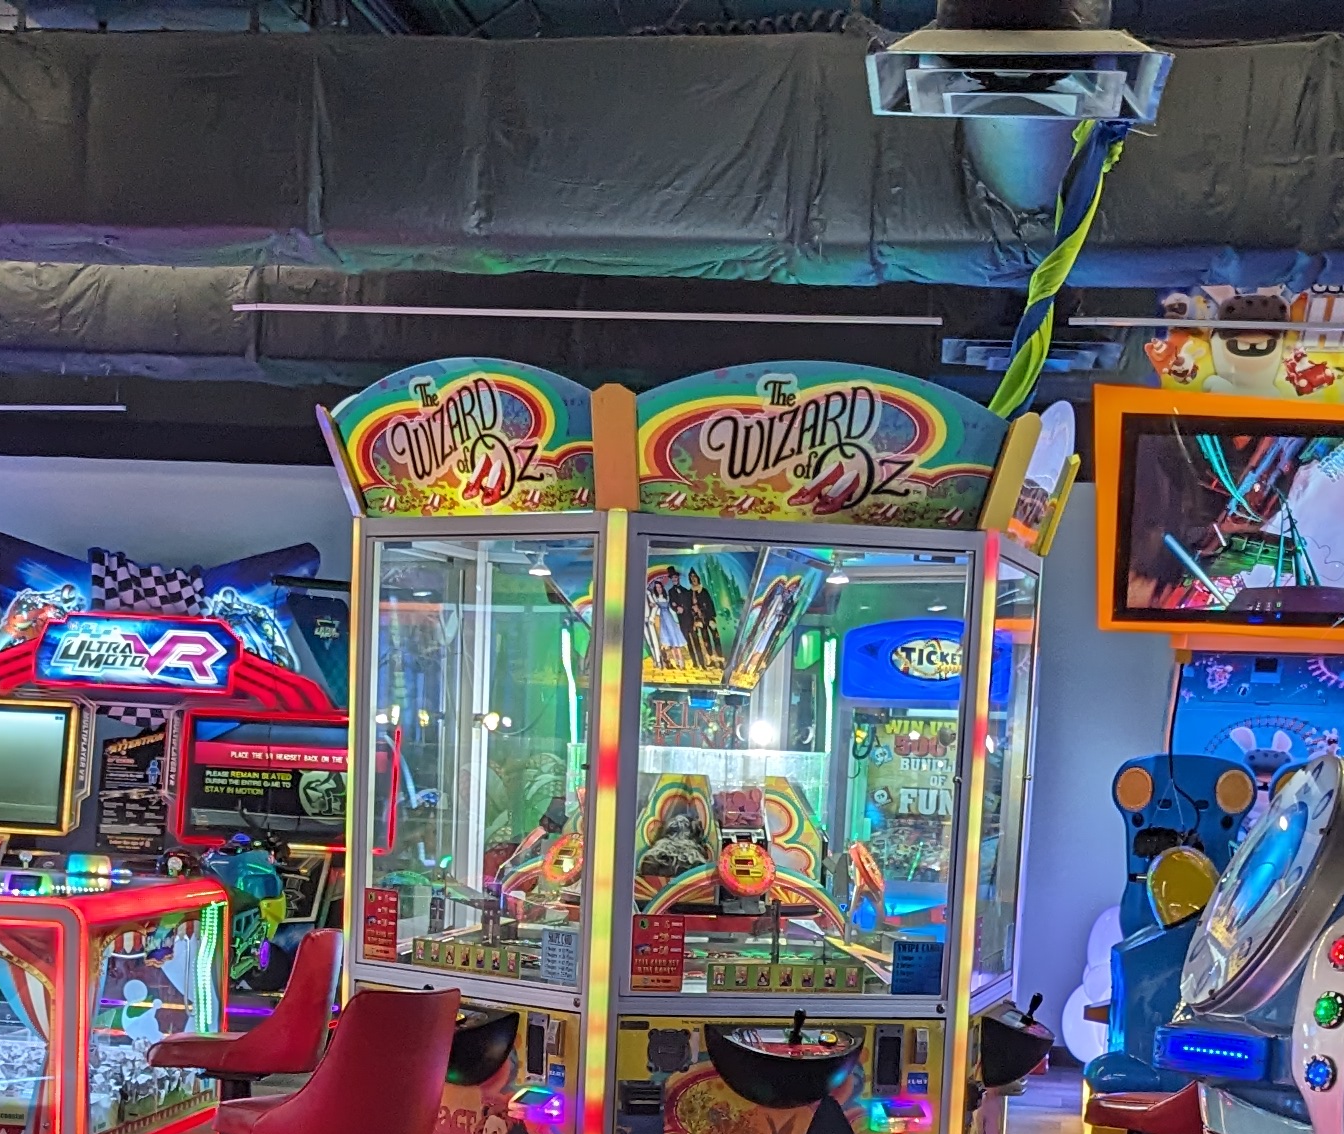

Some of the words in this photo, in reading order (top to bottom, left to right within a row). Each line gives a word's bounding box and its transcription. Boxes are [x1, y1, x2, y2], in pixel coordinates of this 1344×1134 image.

[413, 382, 440, 408] The
[764, 379, 797, 407] The
[391, 377, 498, 480] WIZARD
[707, 385, 876, 480] WIZARD
[456, 445, 472, 474] of
[793, 451, 819, 479] of
[60, 639, 132, 660] ULTRA
[78, 652, 146, 669] MOTO
[120, 633, 220, 678] VR
[885, 719, 925, 735] WIN
[230, 750, 249, 759] PLACE
[252, 751, 263, 760] THE
[205, 770, 230, 778] PLEASE
[230, 771, 260, 779] REMAIN
[929, 775, 947, 787] OF
[205, 785, 226, 793] STAY
[235, 787, 264, 796] MOTION
